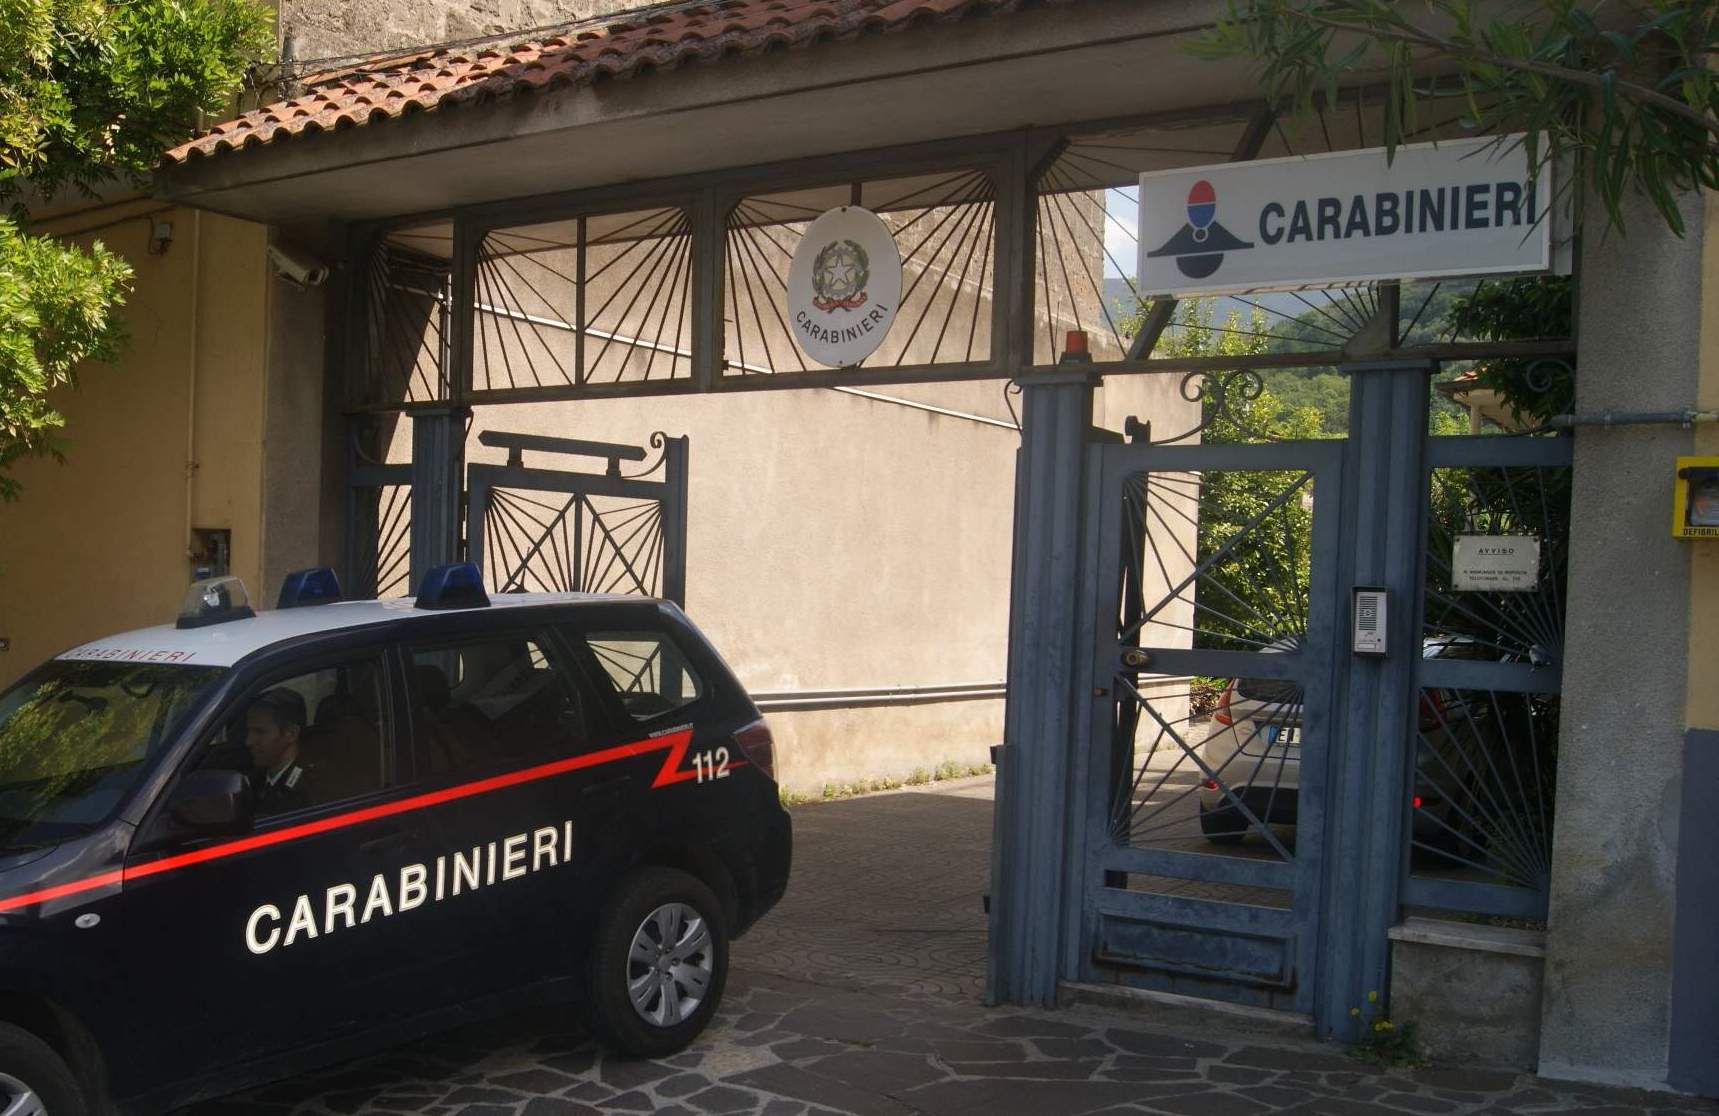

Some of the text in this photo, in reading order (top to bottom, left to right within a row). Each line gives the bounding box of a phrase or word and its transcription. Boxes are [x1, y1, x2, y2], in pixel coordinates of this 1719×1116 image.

[1259, 181, 1536, 245] CARABINIERI
[796, 303, 889, 344] CARABINIERI
[692, 746, 731, 784] 112
[245, 820, 573, 955] CARABINIERI
